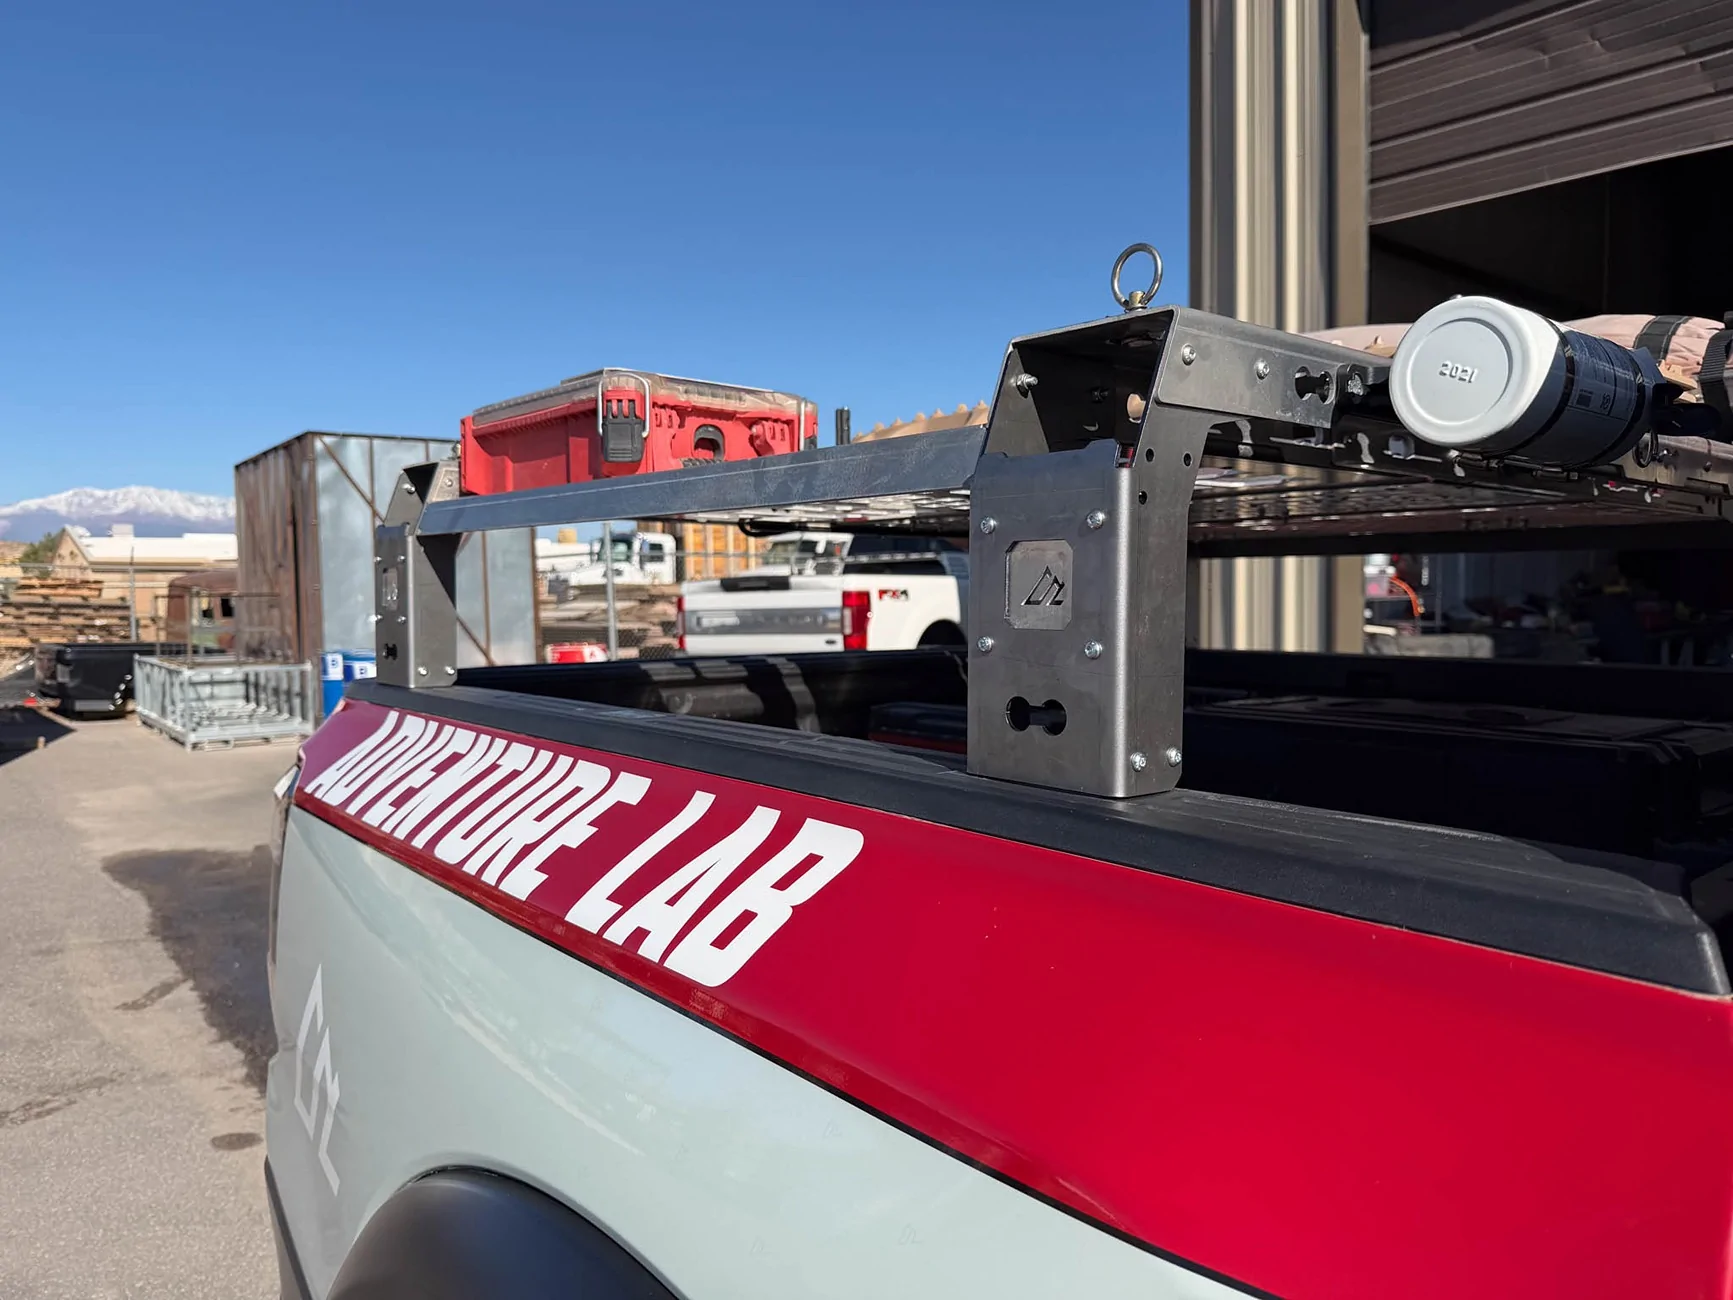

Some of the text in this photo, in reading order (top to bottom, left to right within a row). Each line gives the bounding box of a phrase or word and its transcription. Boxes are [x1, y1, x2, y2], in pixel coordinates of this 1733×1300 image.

[1438, 361, 1477, 384] 2021
[305, 711, 864, 987] ADVENTURE LAB
